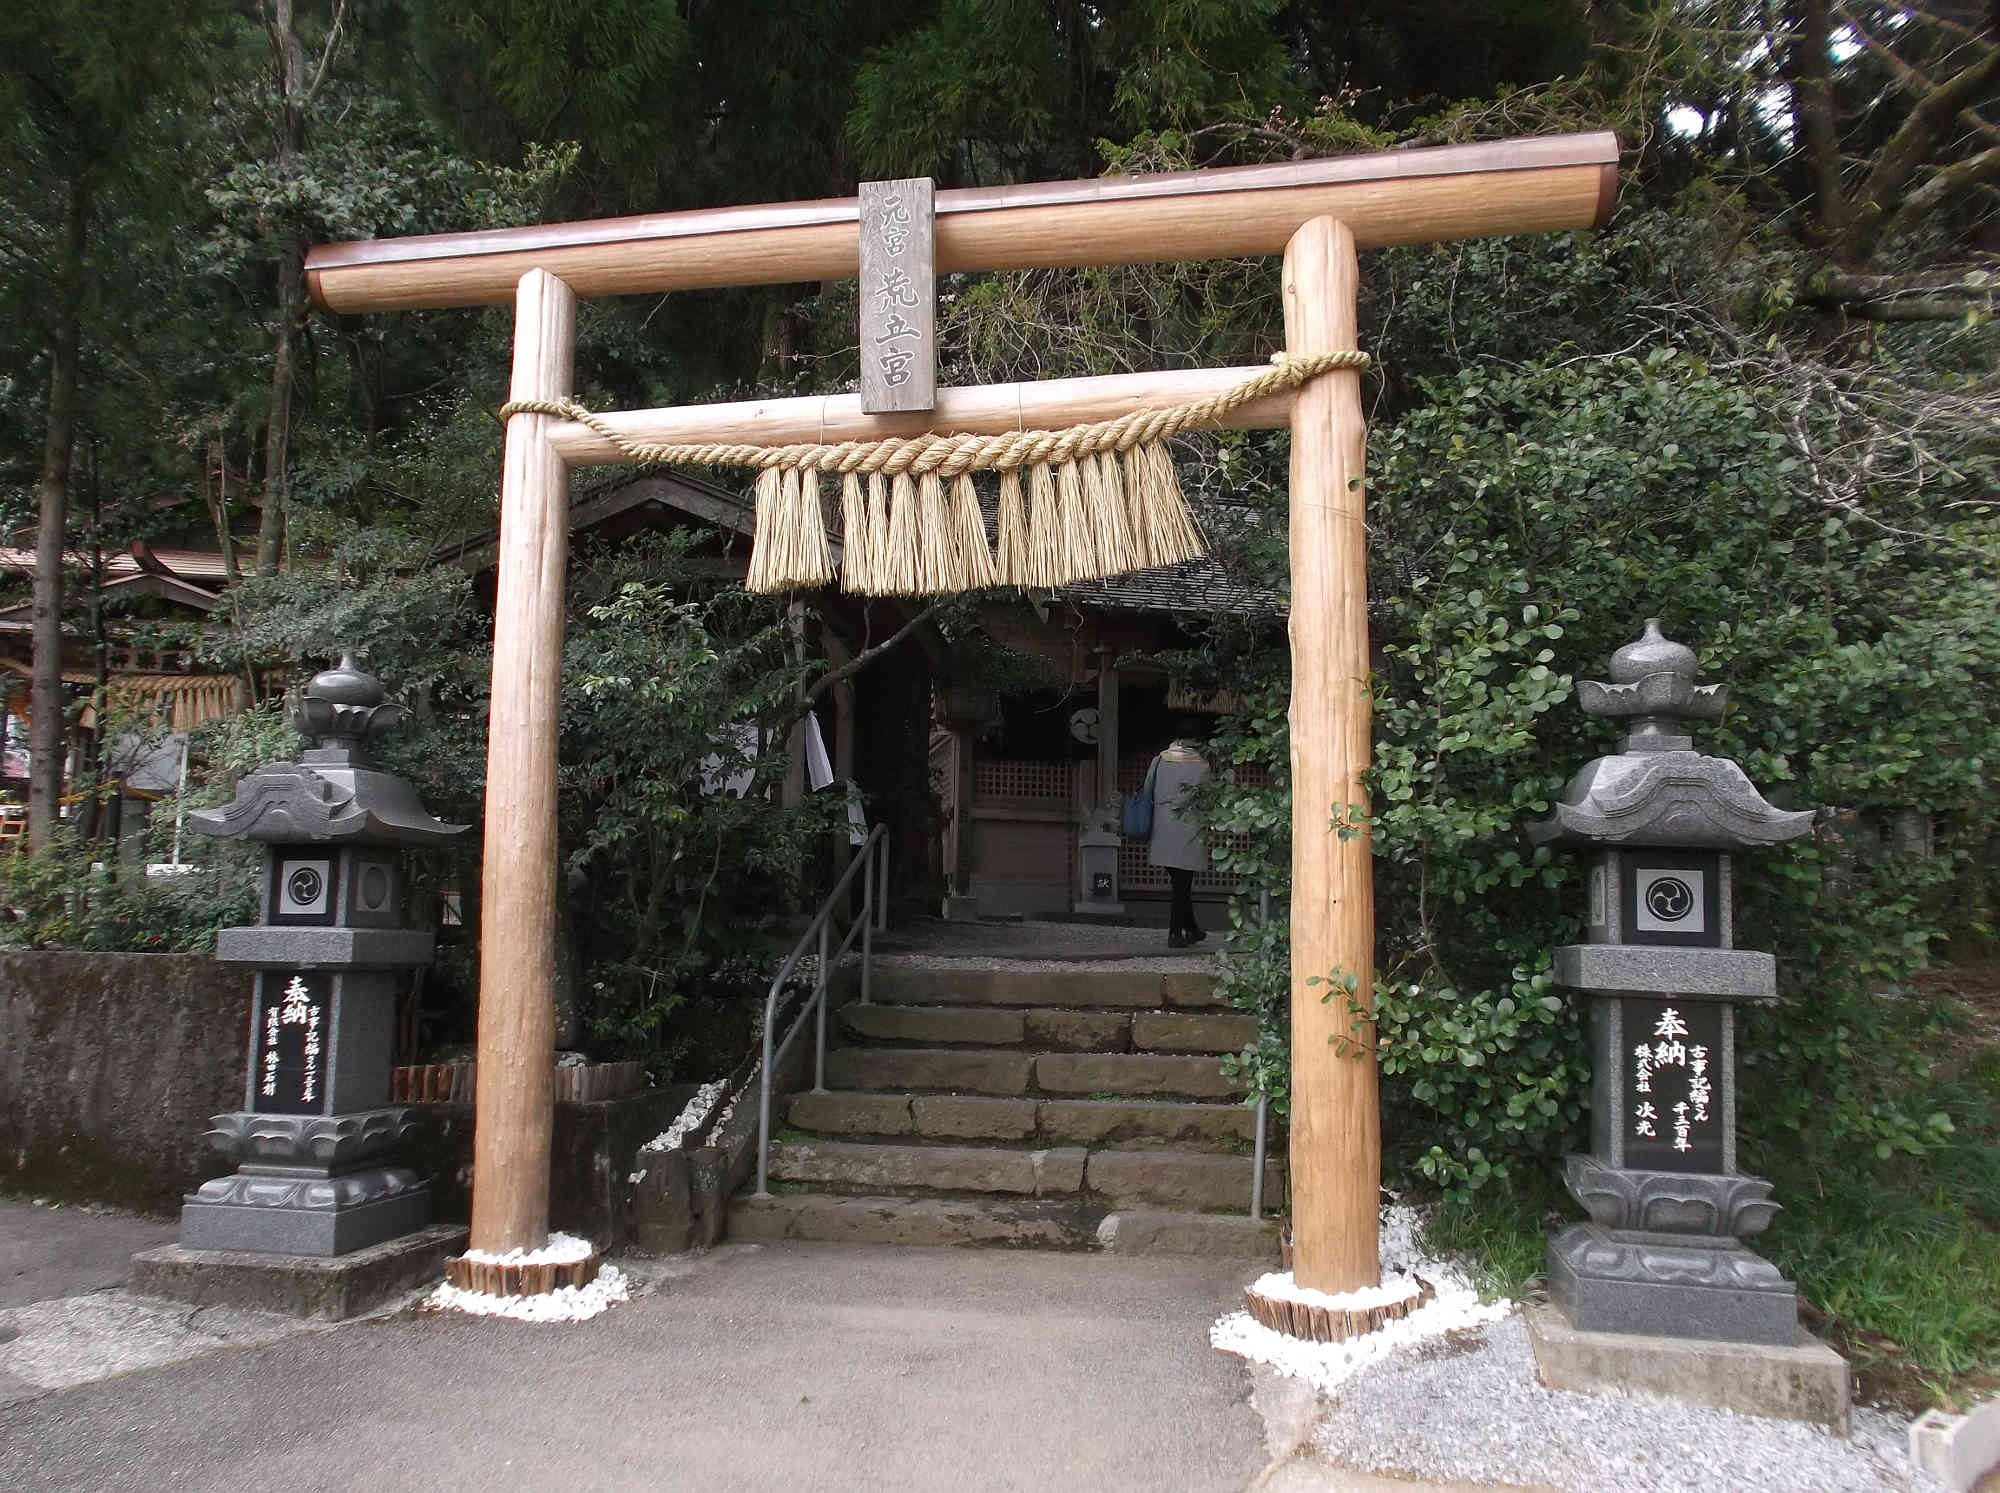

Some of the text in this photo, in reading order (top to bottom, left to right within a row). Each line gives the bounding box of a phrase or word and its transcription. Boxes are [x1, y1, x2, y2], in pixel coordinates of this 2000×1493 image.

[282, 975, 311, 1024] 奉納
[1654, 1007, 1688, 1068] 奉納
[1635, 1043, 1654, 1094] 株式会社
[1672, 1101, 1692, 1153] 千三百年
